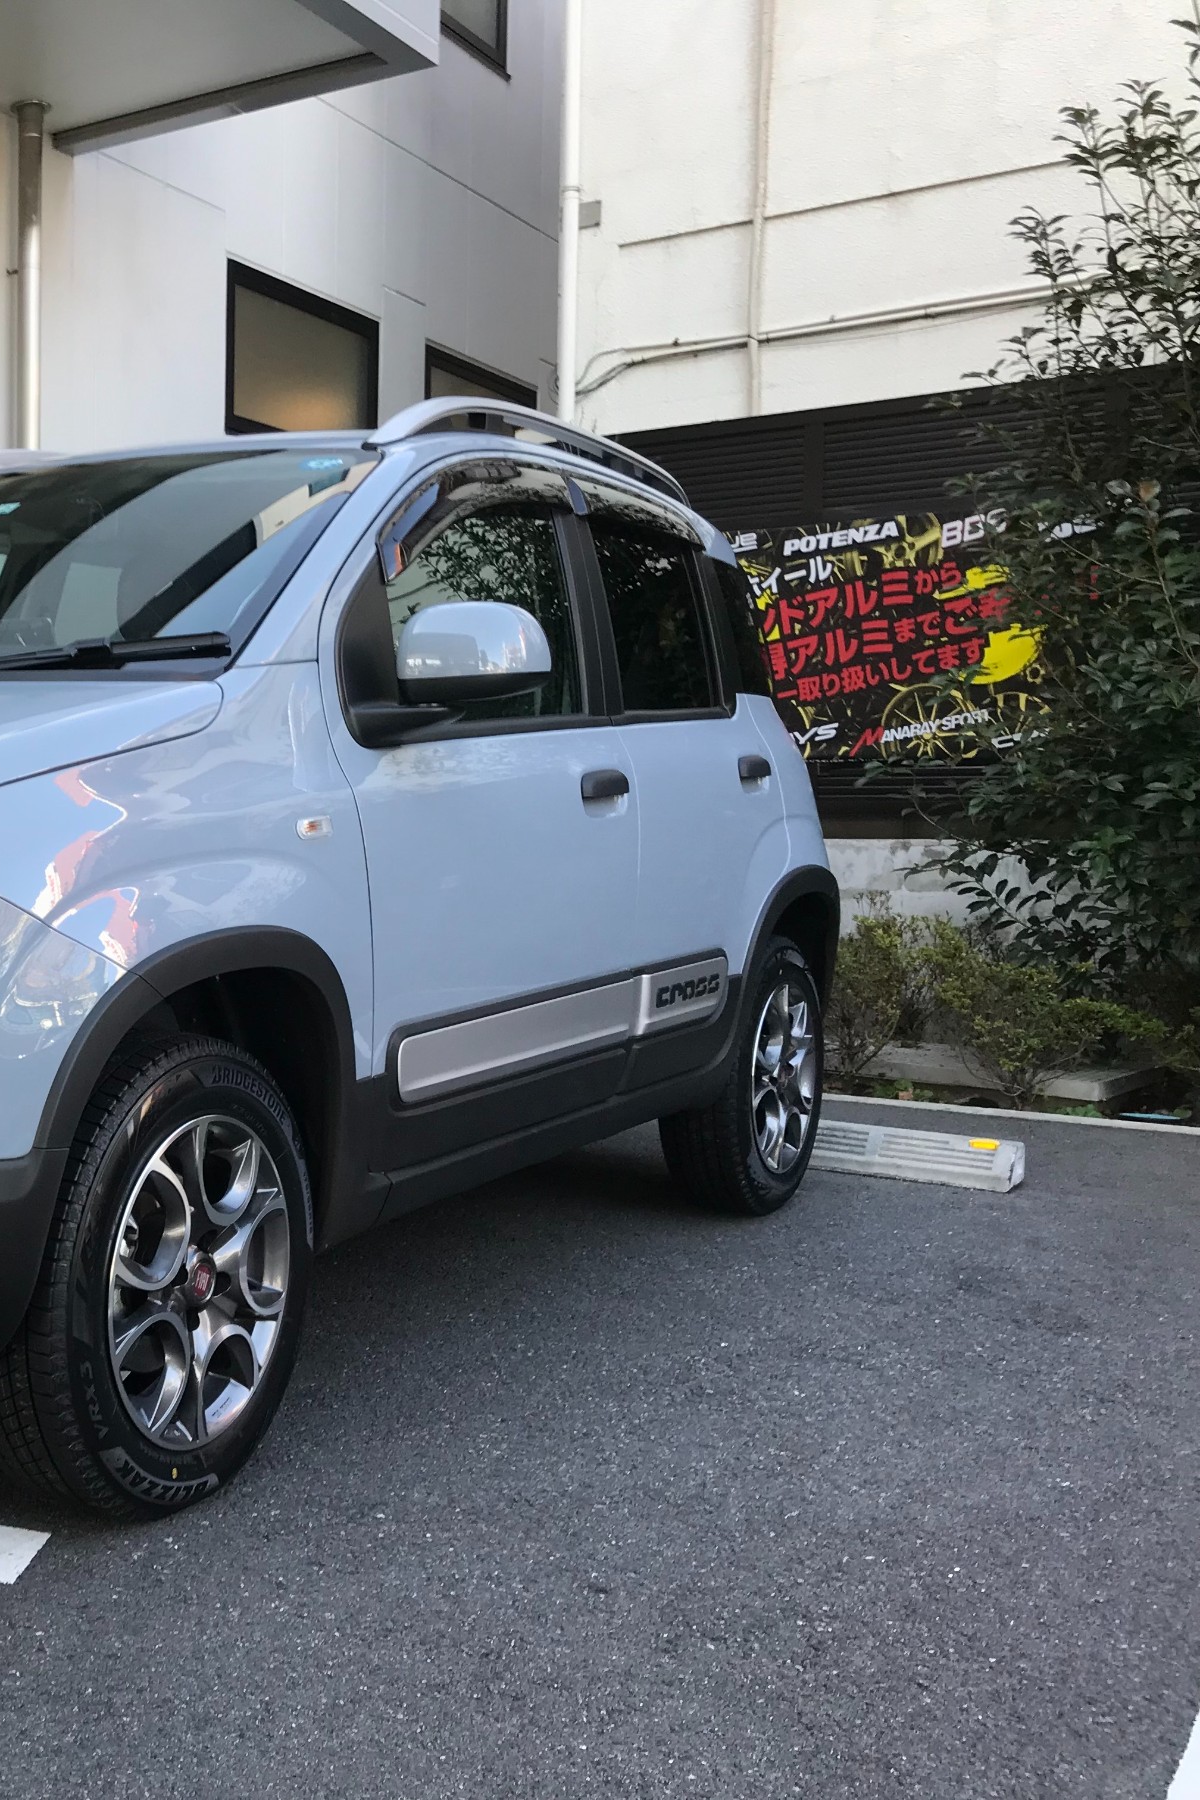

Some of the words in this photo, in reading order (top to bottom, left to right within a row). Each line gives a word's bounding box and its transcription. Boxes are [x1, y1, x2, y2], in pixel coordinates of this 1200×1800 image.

[783, 521, 899, 556] POTENZA
[789, 722, 839, 745] YS
[850, 717, 941, 757] MANARAY
[210, 1064, 288, 1128] BRIDGESTONE
